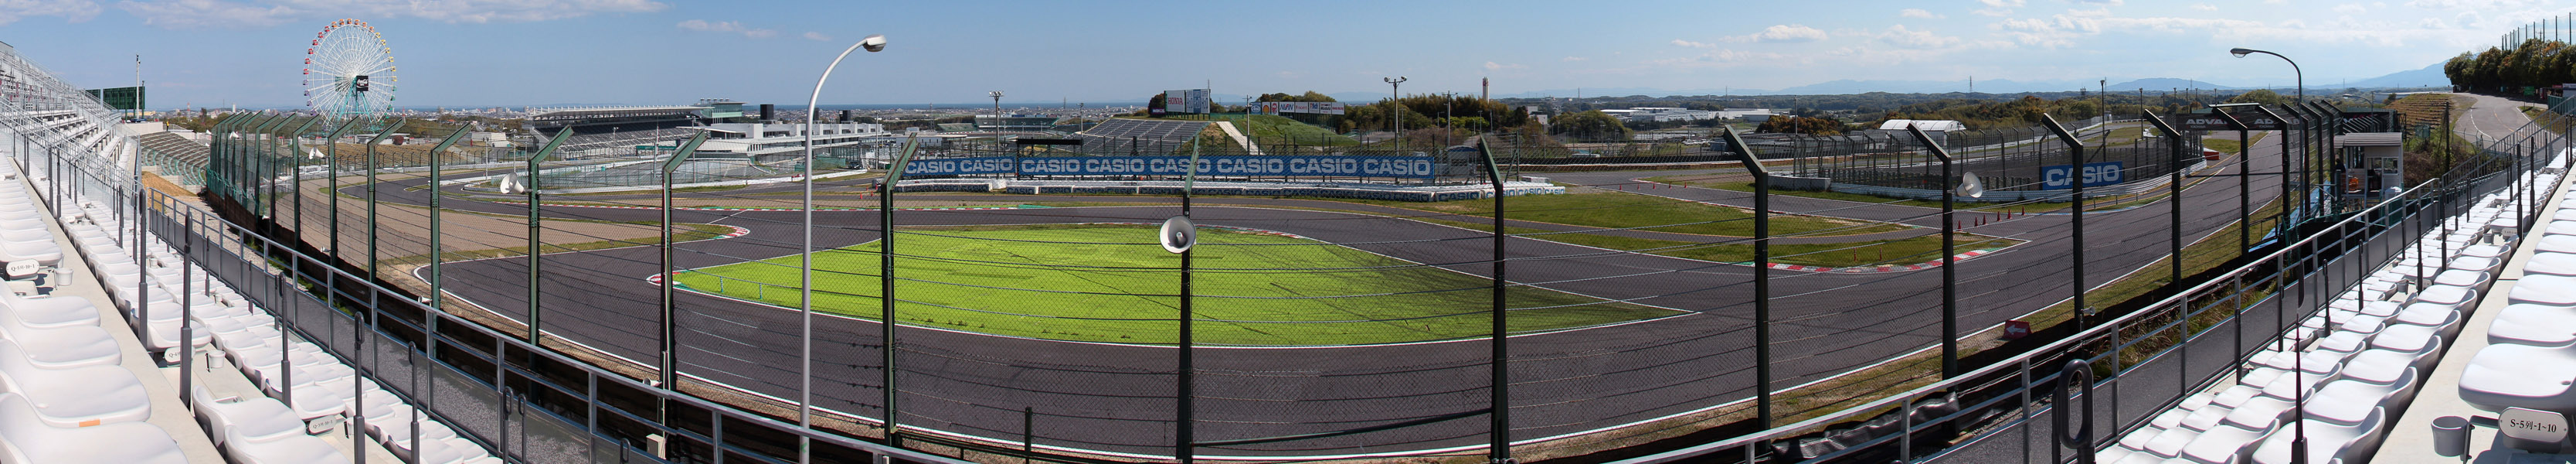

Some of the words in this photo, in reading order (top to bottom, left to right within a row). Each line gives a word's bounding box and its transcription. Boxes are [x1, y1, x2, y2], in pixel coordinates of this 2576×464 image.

[906, 161, 956, 174] CASIO
[960, 159, 1014, 172] CASIO
[1021, 159, 1080, 172] CASIO
[1086, 159, 1145, 172] CASIO
[1150, 159, 1211, 172] CASO
[1217, 159, 1284, 173] CASIO
[1290, 158, 1358, 174] CASIO
[1363, 159, 1430, 176] CASIO
[1438, 192, 1480, 201] CASIO
[1487, 189, 1515, 199] CSIO
